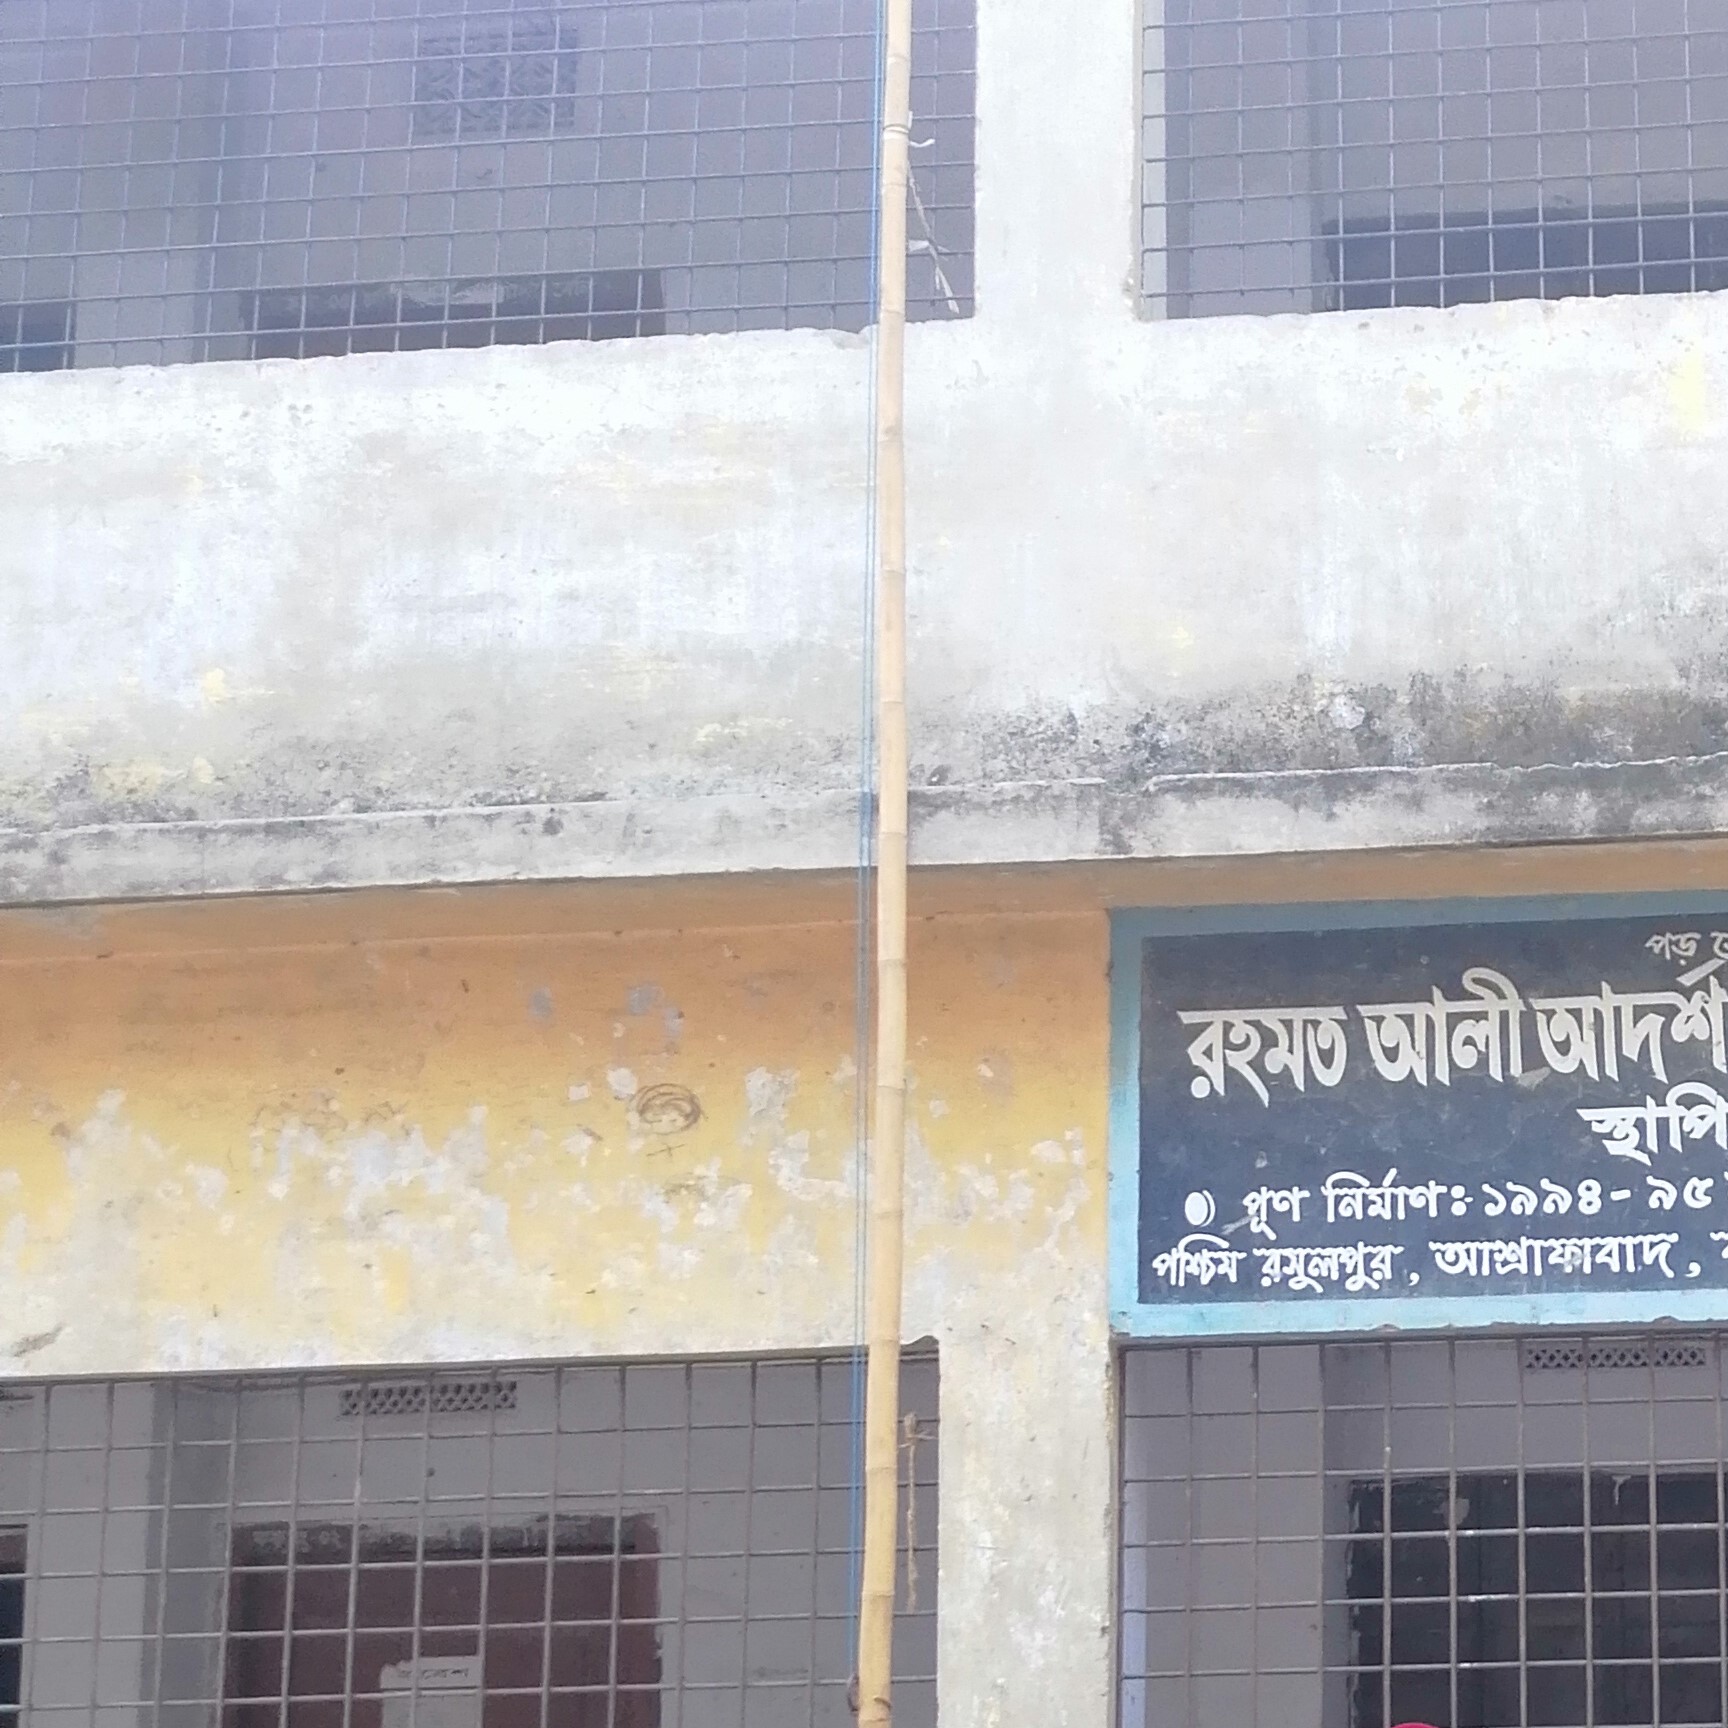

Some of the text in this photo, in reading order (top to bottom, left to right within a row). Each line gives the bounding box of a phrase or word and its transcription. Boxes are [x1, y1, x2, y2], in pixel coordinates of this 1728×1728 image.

[1645, 931, 1701, 966] পড়
[1177, 1005, 1347, 1107] রহমত
[1356, 967, 1530, 1087] আলী
[1151, 1233, 1248, 1288] পশ্চিম
